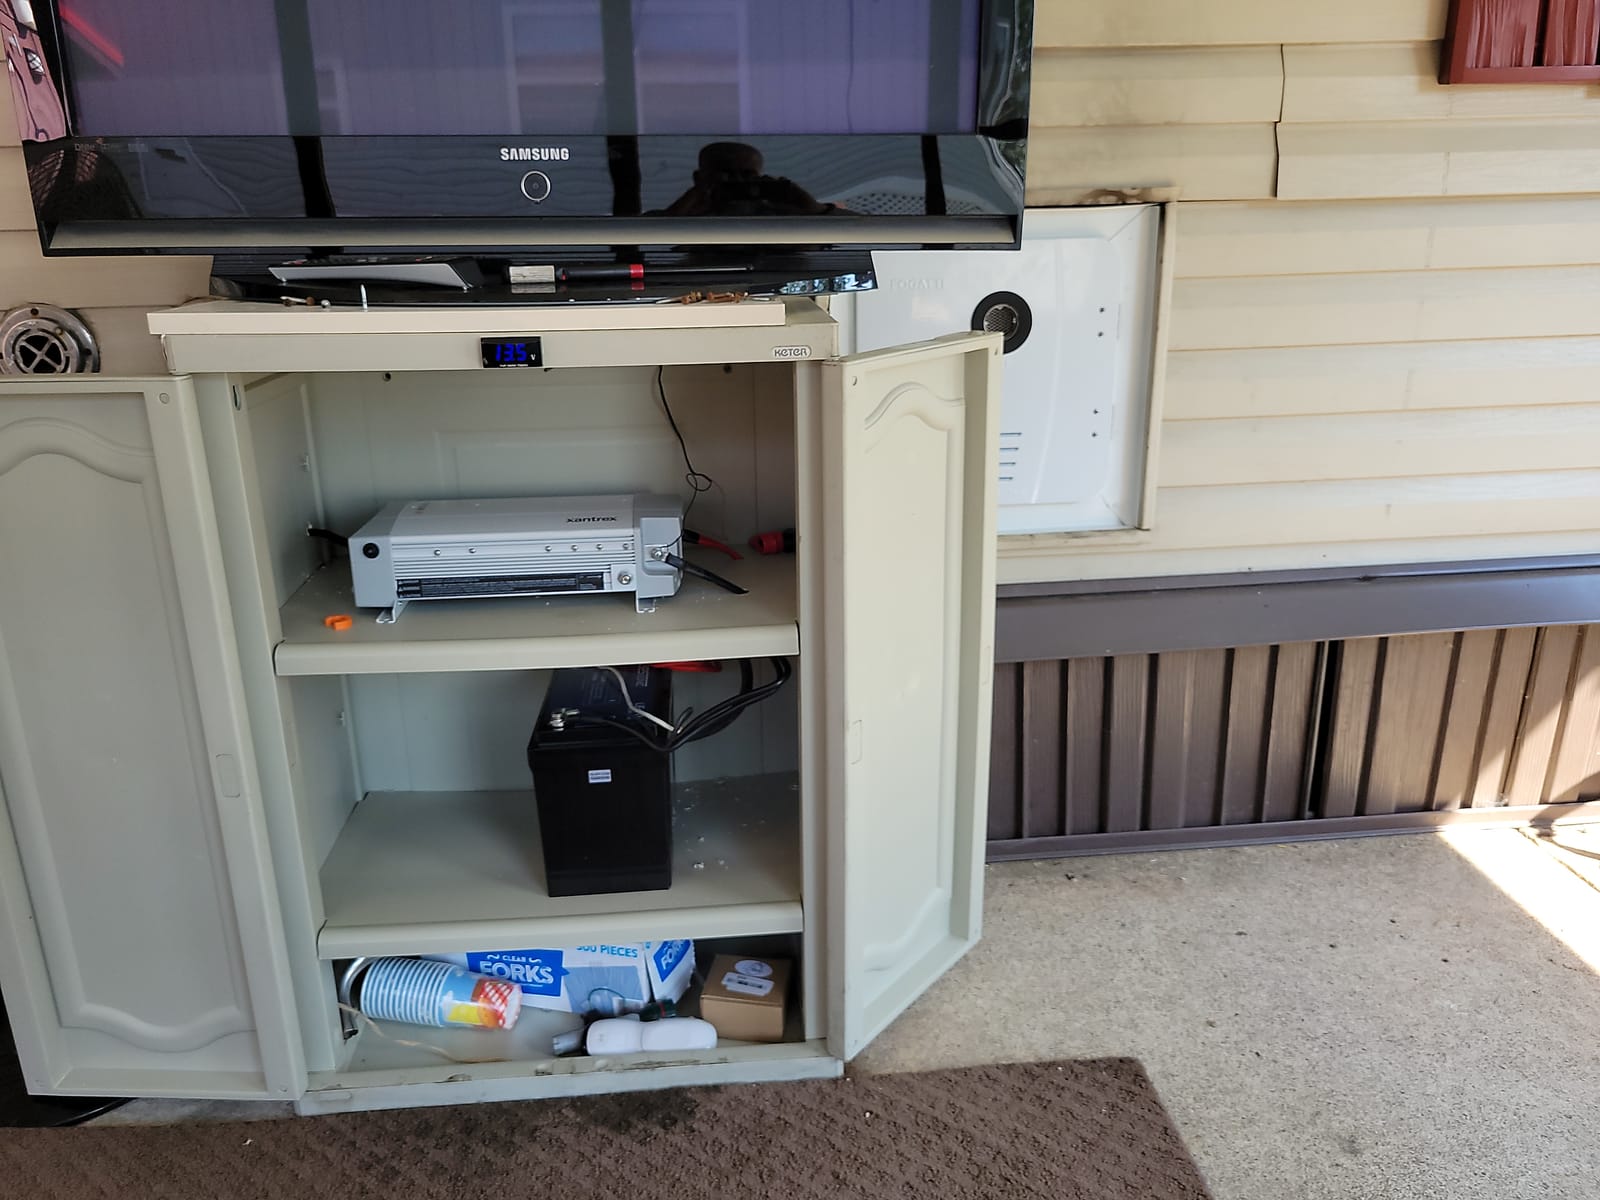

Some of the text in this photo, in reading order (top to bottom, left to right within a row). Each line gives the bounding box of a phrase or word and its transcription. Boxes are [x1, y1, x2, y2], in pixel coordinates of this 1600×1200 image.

[500, 147, 569, 161] SAMSUNG
[600, 944, 638, 958] PIECES
[480, 960, 554, 984] FORKS
